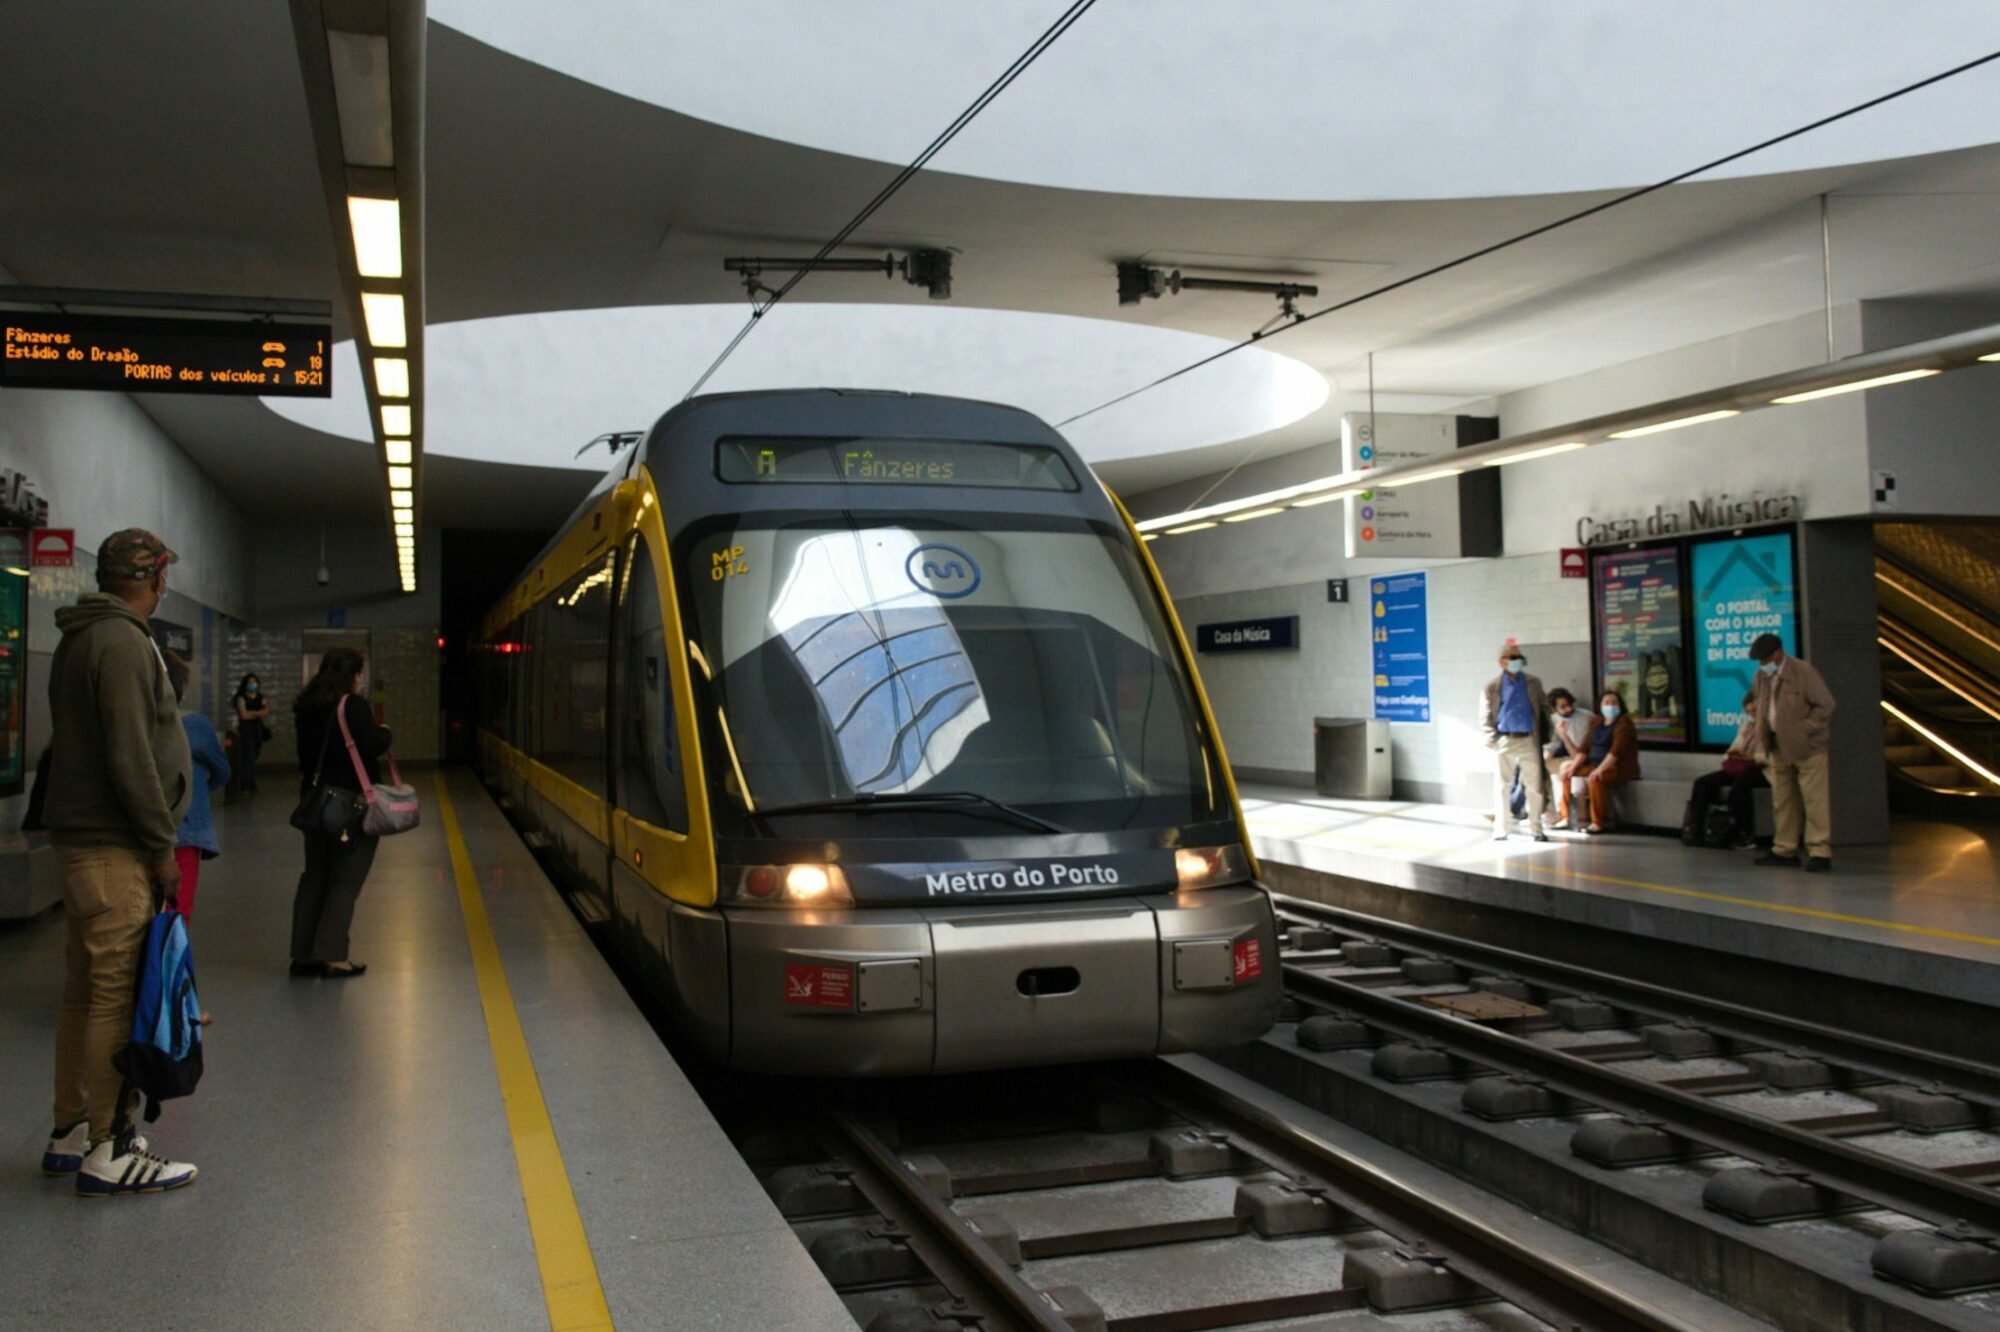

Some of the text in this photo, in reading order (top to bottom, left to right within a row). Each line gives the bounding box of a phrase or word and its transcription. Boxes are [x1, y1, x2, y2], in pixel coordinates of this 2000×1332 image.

[6, 327, 323, 354] Fânzeres 1
[6, 344, 323, 370] Estádio do Dragão 19
[124, 364, 172, 380] PORTAS
[179, 367, 204, 381] dos
[210, 370, 266, 384] veículos
[294, 370, 323, 385] 15:21
[845, 450, 955, 479] Fânzeres
[1576, 491, 1800, 548] Casa da Música
[712, 545, 745, 566] MP
[711, 561, 749, 581] 014
[1333, 586, 1342, 600] 1
[1716, 599, 1770, 616] O PORTAL
[1705, 613, 1783, 632] COM O MAIOR
[1214, 626, 1271, 644] Casa da Música
[1726, 631, 1741, 645] DE
[1707, 647, 1724, 661] EM
[926, 863, 1119, 896] Metro do Porto
